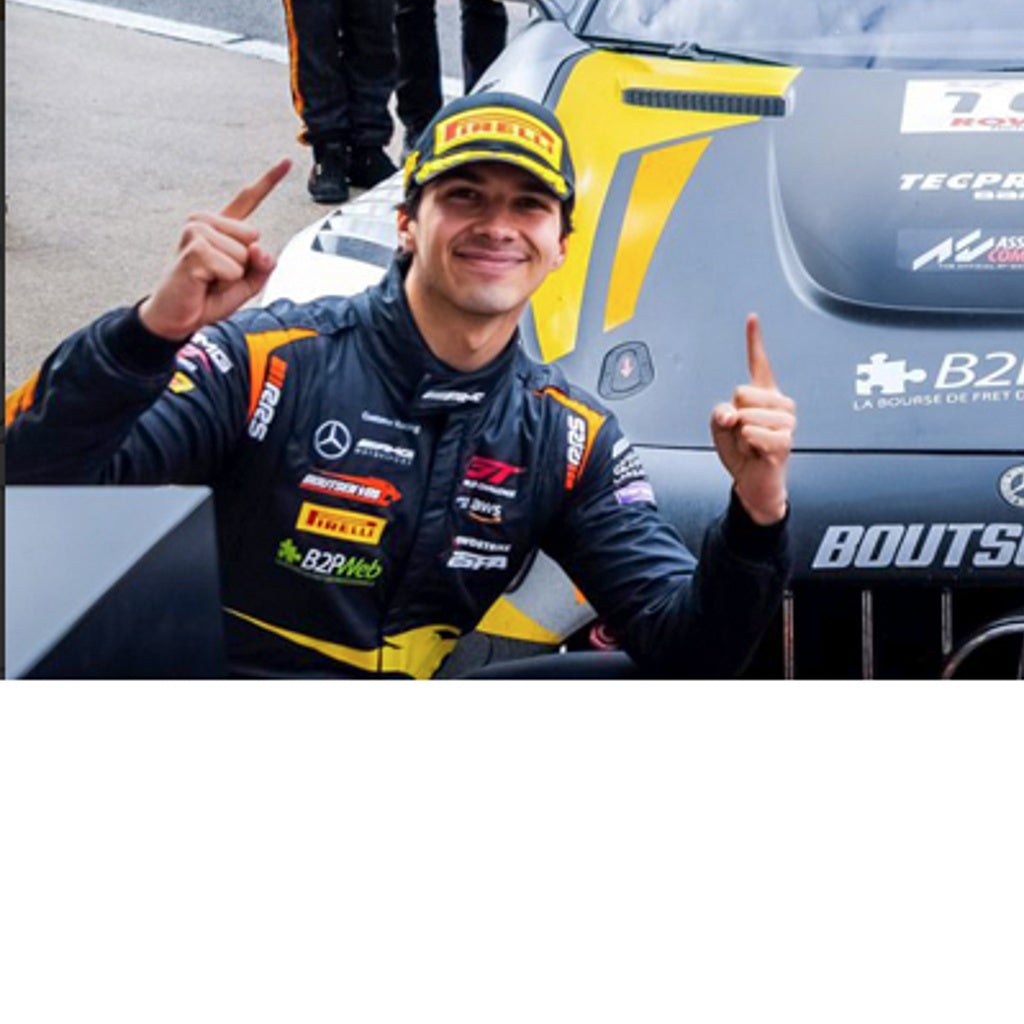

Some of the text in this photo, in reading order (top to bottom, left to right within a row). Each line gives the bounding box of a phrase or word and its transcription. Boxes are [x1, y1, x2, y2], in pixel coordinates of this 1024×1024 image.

[445, 113, 555, 155] PIRELLI
[853, 399, 874, 411] LA
[877, 394, 943, 409] BOURSE
[946, 392, 968, 404] DE
[972, 390, 1011, 402] FRET
[306, 509, 378, 538] PIRELLI
[302, 548, 384, 579] B2PWeb
